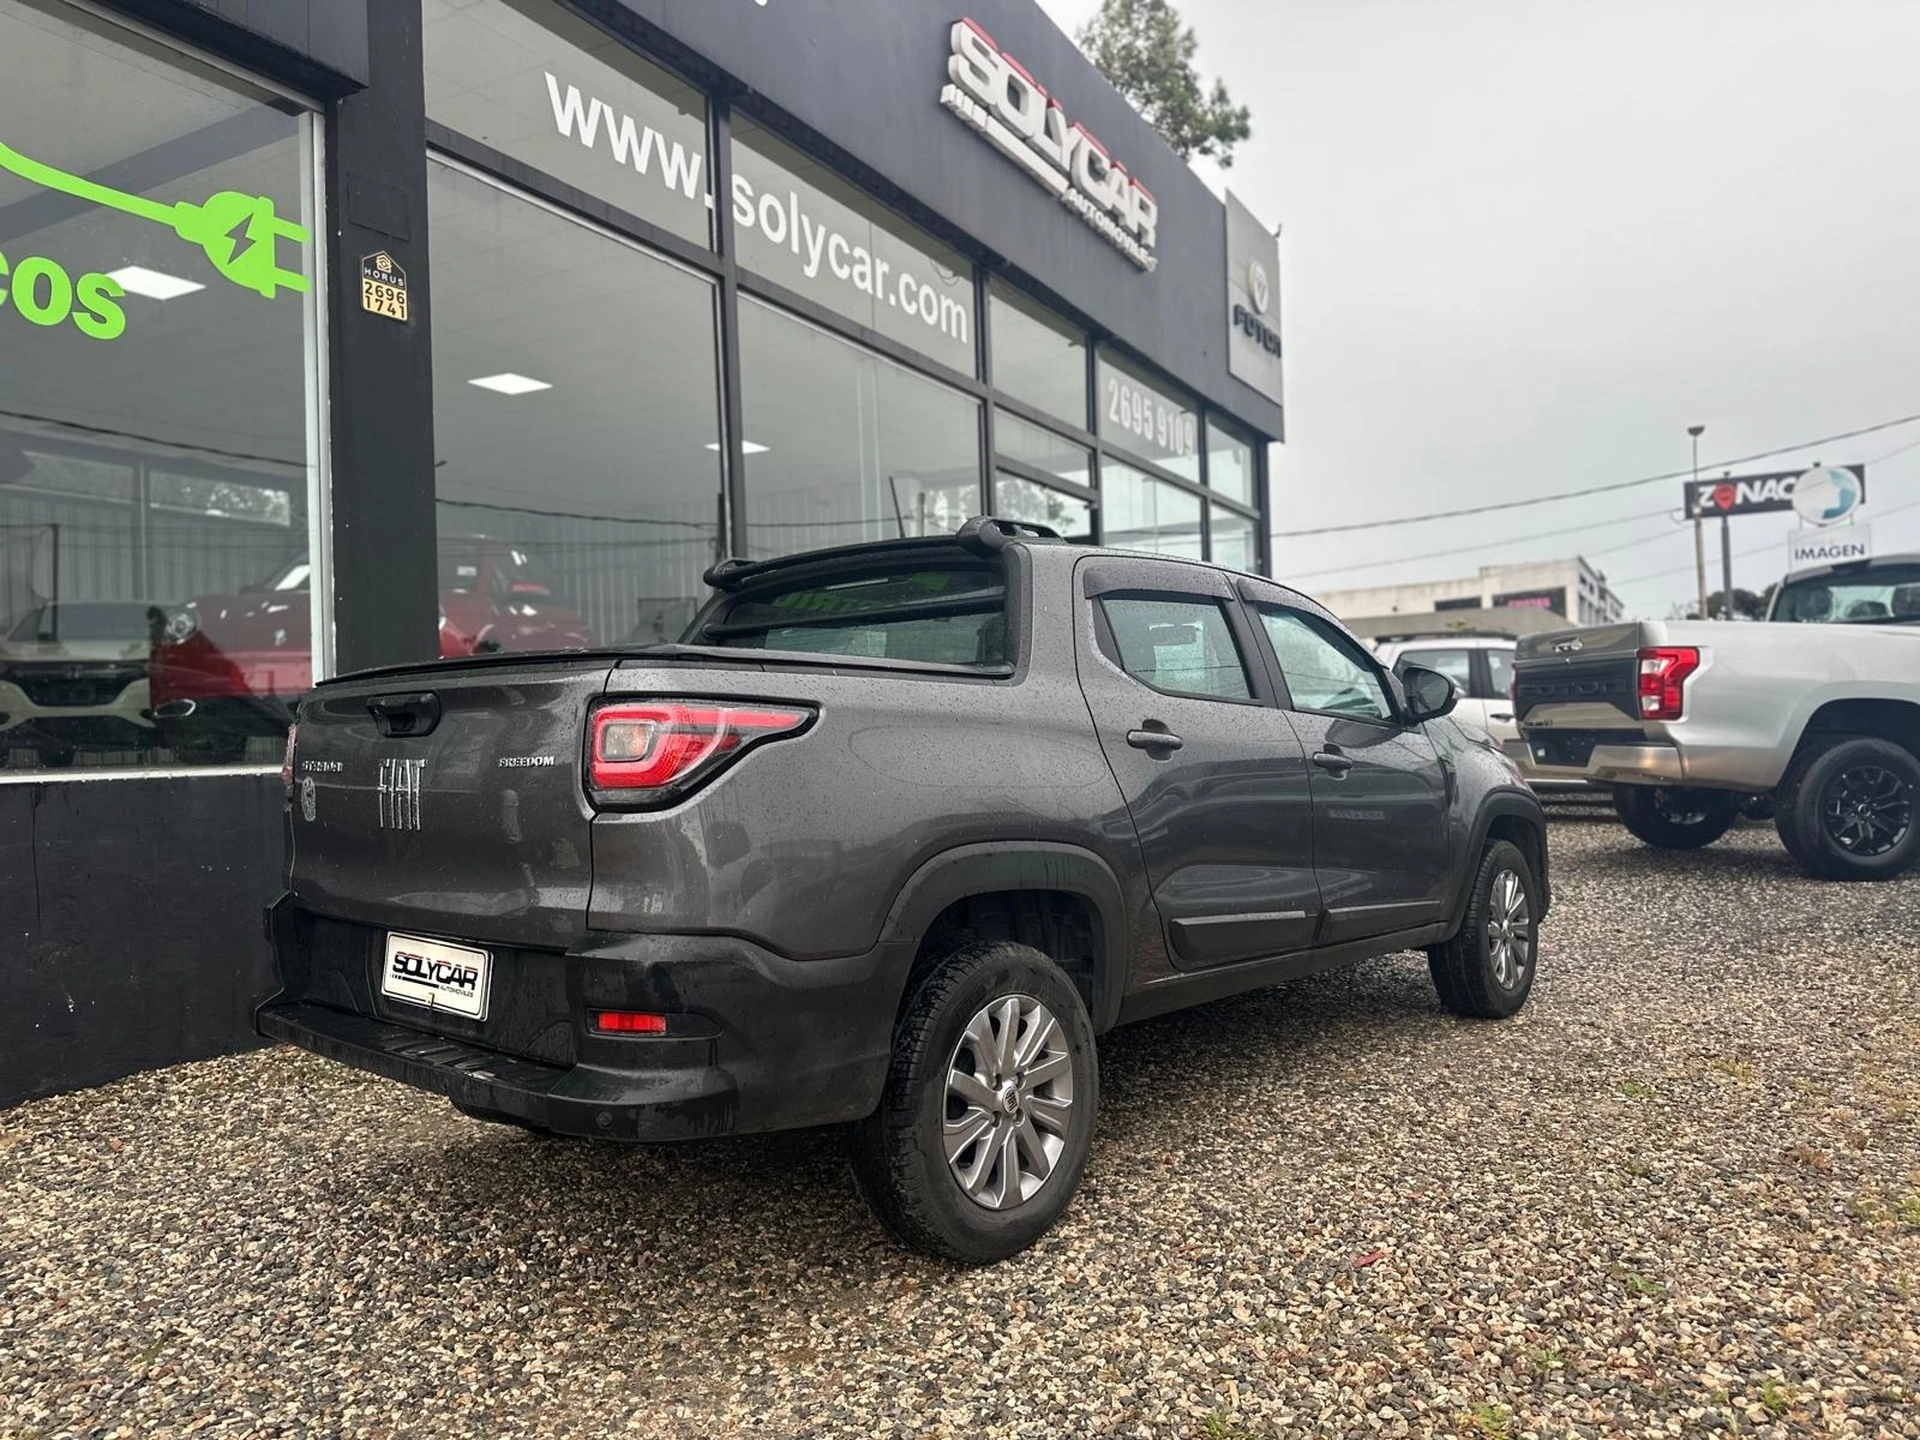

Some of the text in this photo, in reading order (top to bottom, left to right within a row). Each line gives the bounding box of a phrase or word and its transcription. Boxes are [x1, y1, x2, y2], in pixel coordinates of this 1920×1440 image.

[948, 17, 1158, 248] SOLYCAR
[1061, 187, 1158, 272] AUTOMOVILES
[364, 267, 404, 287] HORUS
[365, 281, 405, 305] 2696
[365, 295, 405, 319] 1741
[1108, 378, 1193, 459] 2695 9109
[1795, 543, 1865, 561] IMAGEN
[499, 756, 556, 768] FREEDOM
[377, 758, 427, 830] FIAT
[392, 951, 479, 991] SOLYCAR
[440, 986, 475, 998] AUTOMOVILES
